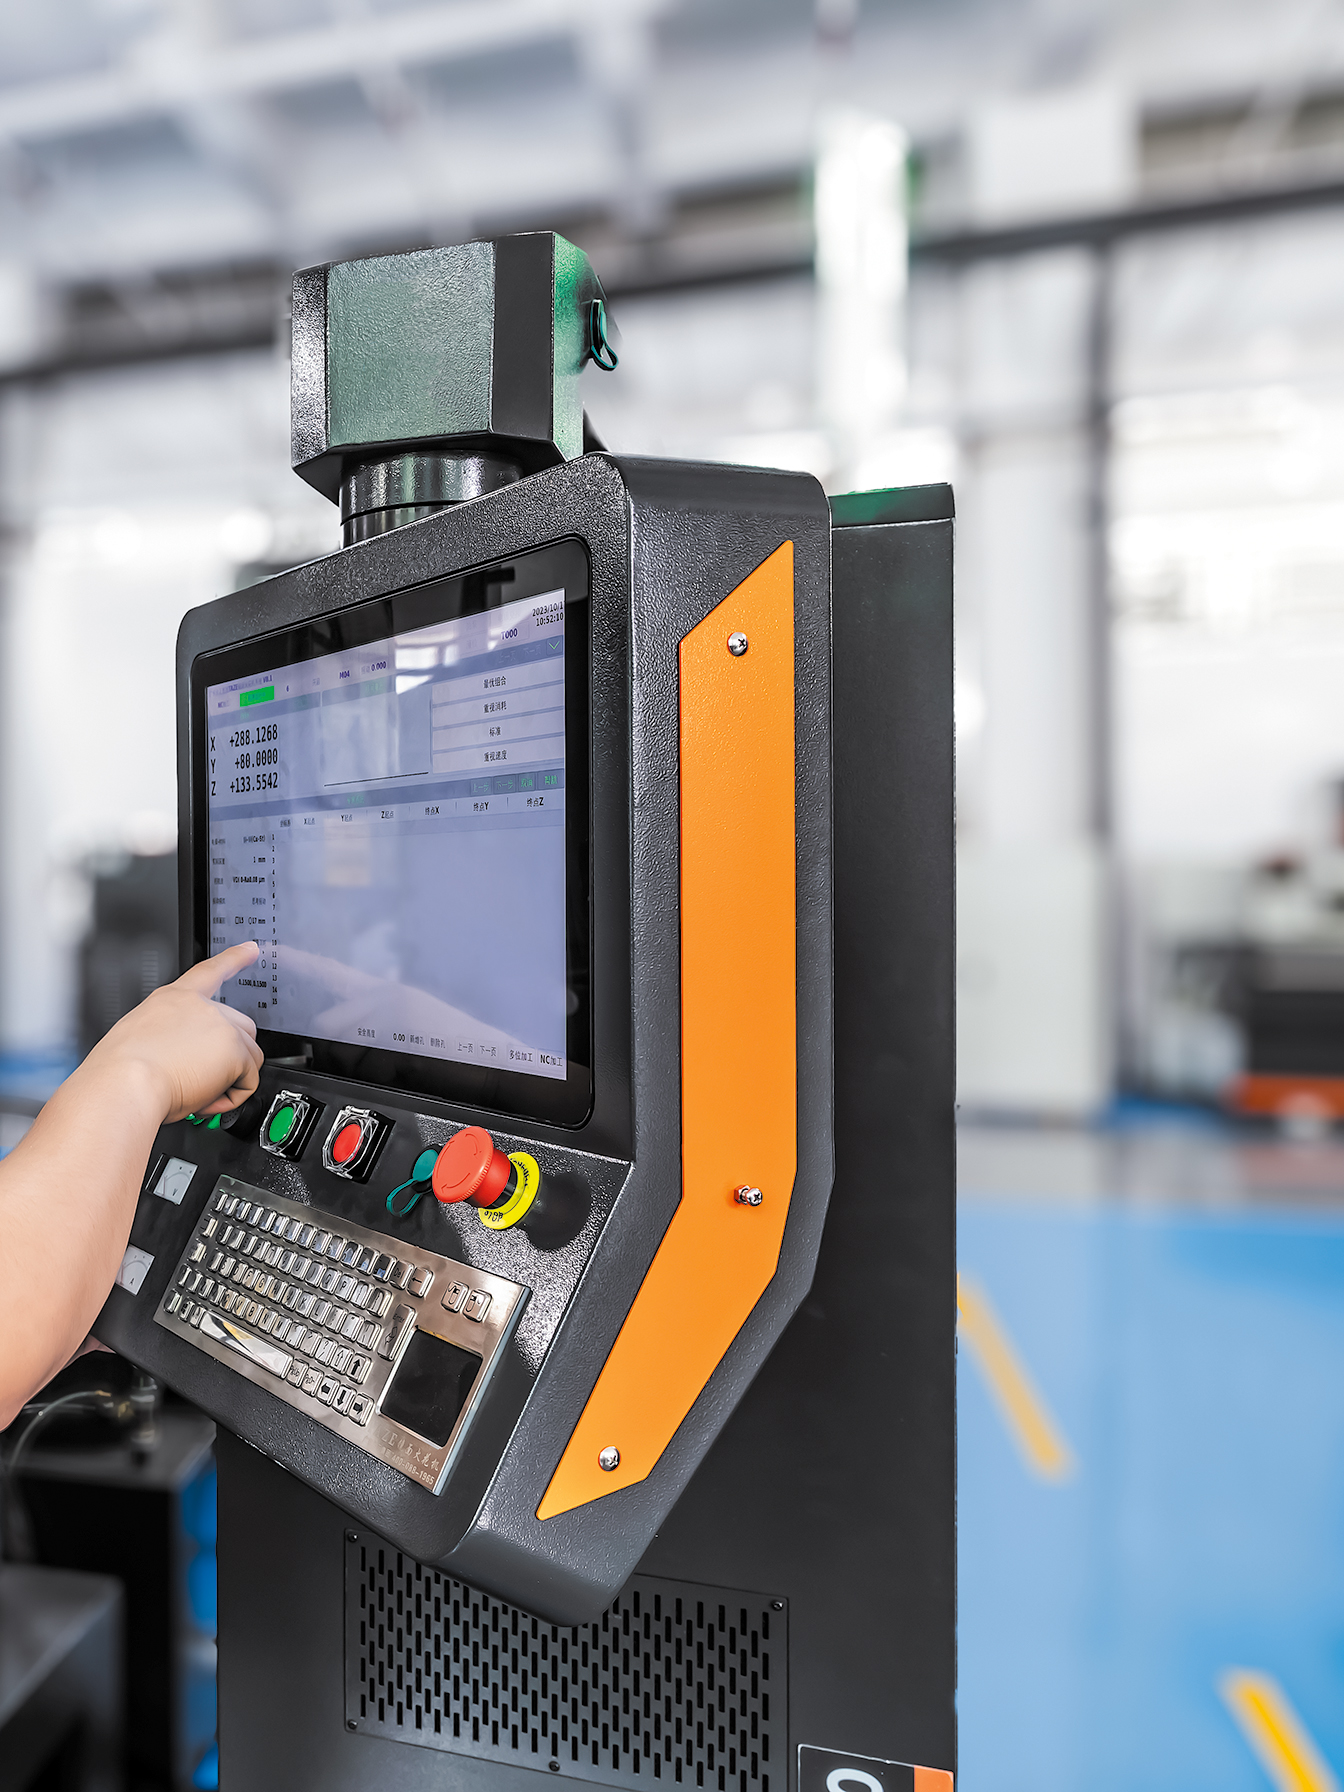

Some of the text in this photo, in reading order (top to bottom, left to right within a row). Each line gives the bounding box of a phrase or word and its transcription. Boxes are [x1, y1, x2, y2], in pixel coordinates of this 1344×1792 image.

[535, 611, 564, 627] 10:52:10
[500, 627, 518, 640] T000
[210, 724, 278, 752] X +288.1268
[489, 726, 501, 738] 标准
[210, 748, 278, 774] Y +80.0000
[211, 772, 278, 796] Z +133.5542
[393, 1032, 406, 1043] 0.00
[457, 1042, 474, 1054] 上一页
[479, 1045, 497, 1057] 下一页
[540, 1054, 563, 1067] NC加工
